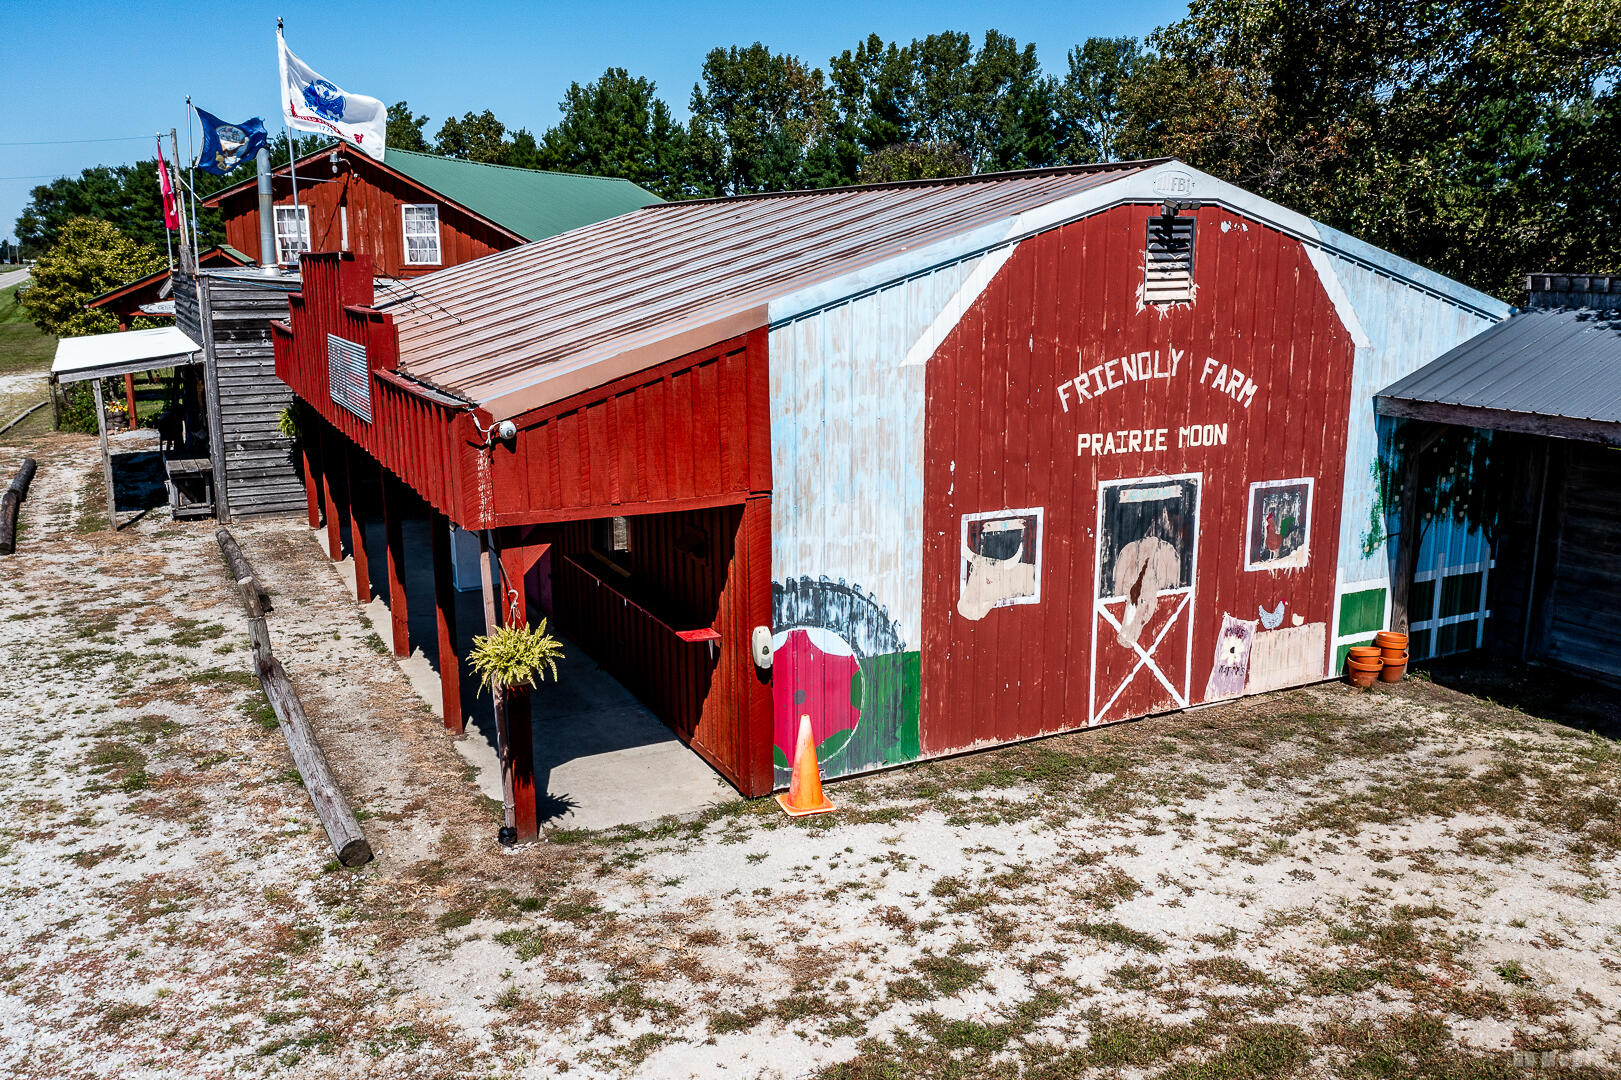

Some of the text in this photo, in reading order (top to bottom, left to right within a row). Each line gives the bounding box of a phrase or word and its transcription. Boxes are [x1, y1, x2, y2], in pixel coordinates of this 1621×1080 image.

[1057, 348, 1259, 413] FRIENDLY FARM
[1077, 422, 1228, 457] PRAIRIE MOON
